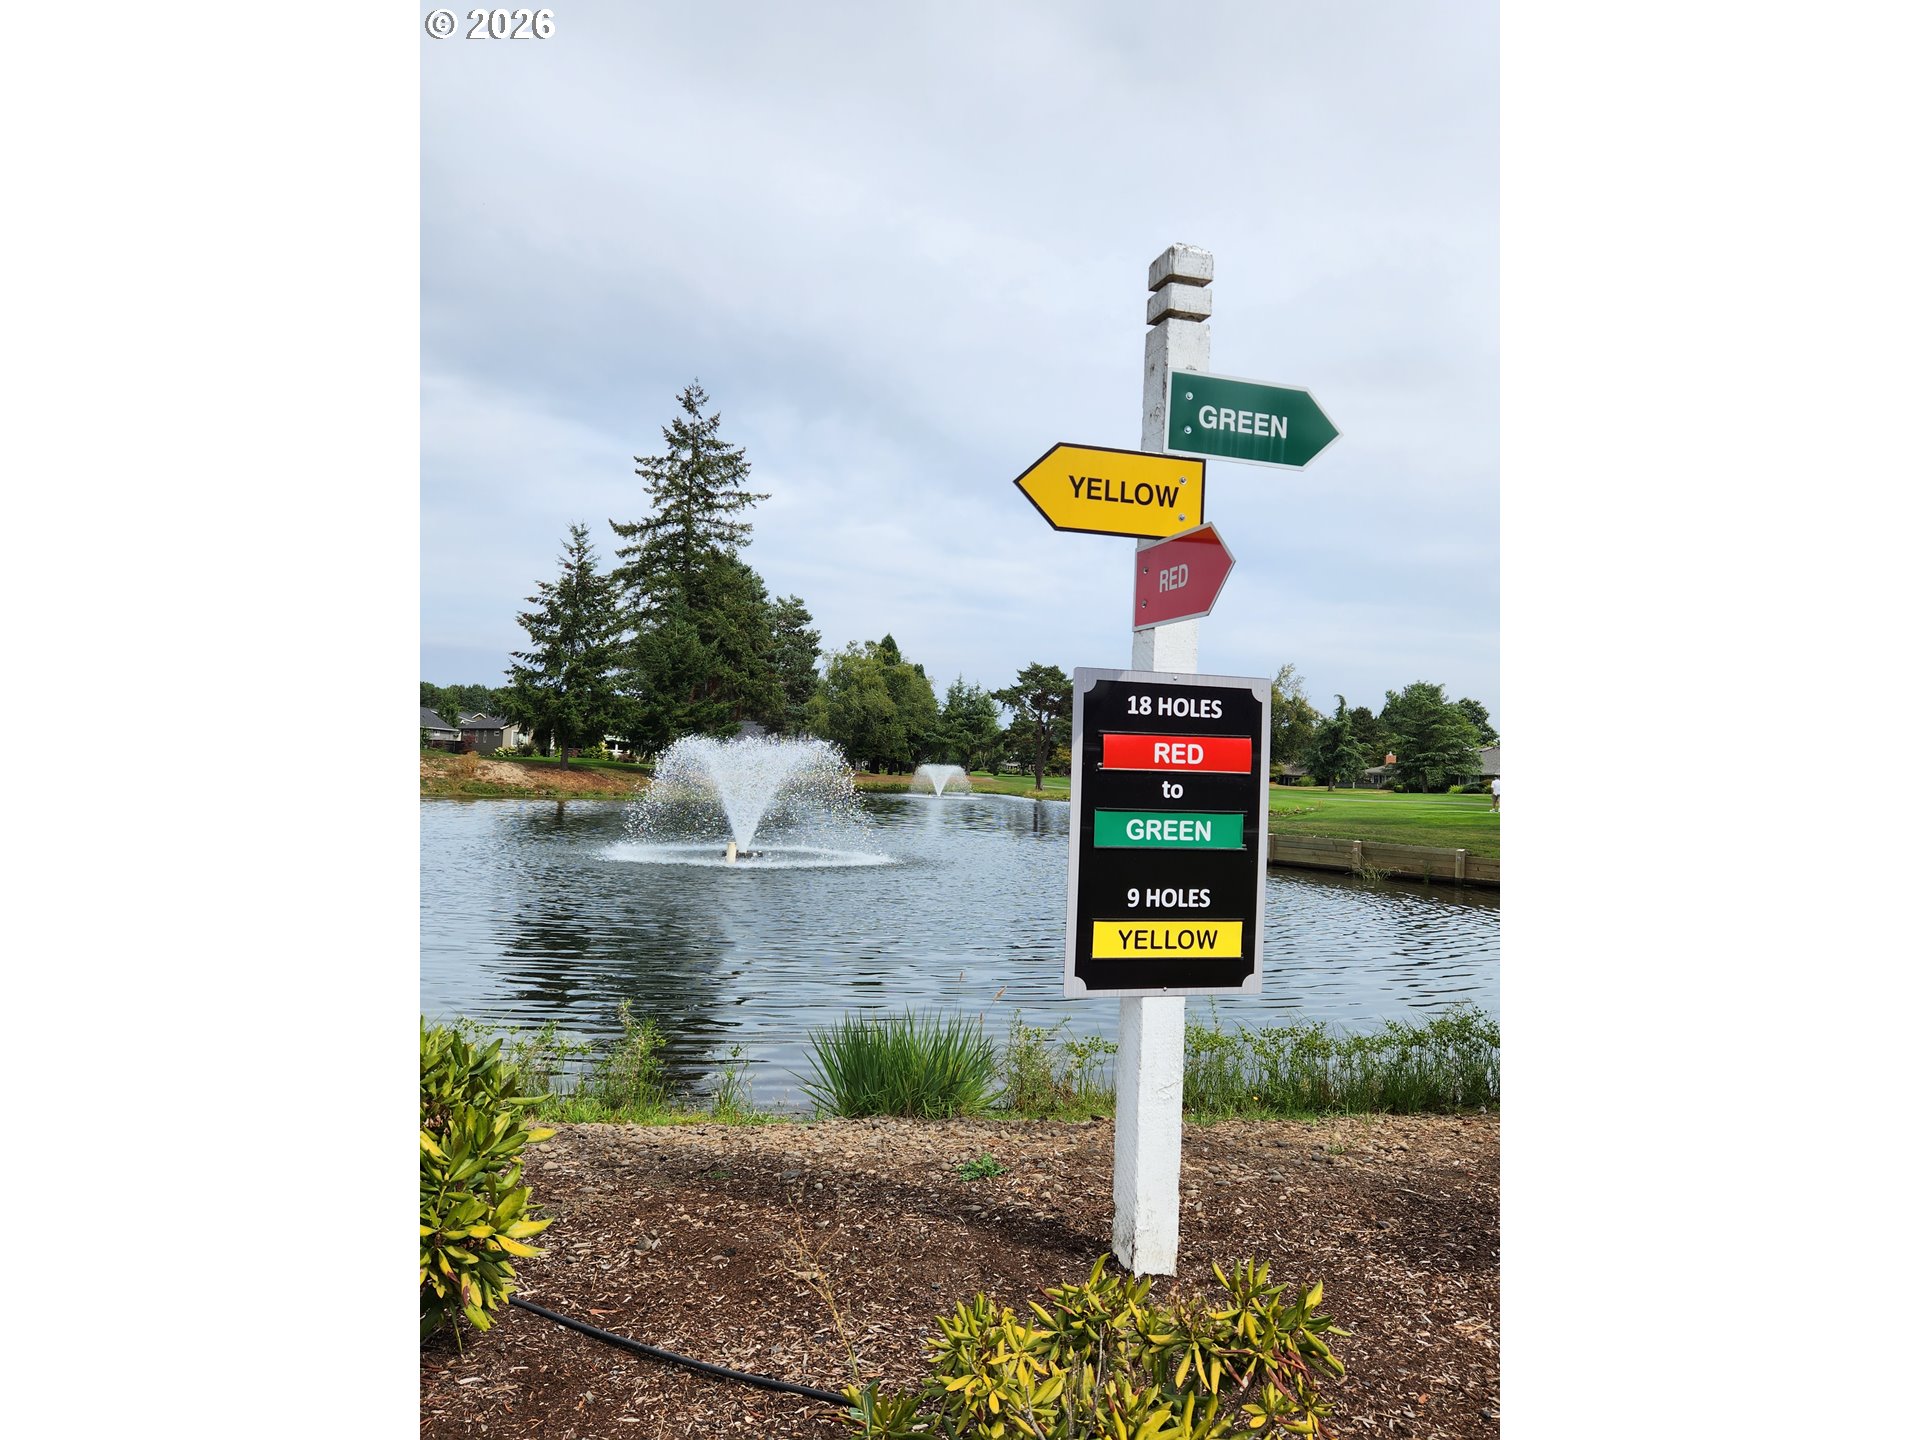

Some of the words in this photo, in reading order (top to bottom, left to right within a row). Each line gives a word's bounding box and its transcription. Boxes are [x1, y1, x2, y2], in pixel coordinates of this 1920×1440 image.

[1198, 405, 1288, 439] GREEN
[1068, 475, 1179, 508] YELLOW
[1159, 564, 1188, 593] RED
[1127, 695, 1152, 715] 18
[1158, 697, 1222, 719] HOLES
[1154, 742, 1204, 765] RED
[1162, 780, 1184, 799] to
[1126, 819, 1212, 842] GREEN
[1127, 888, 1140, 908] 9
[1146, 888, 1211, 908] HOLES
[1118, 929, 1218, 950] YELLOW
